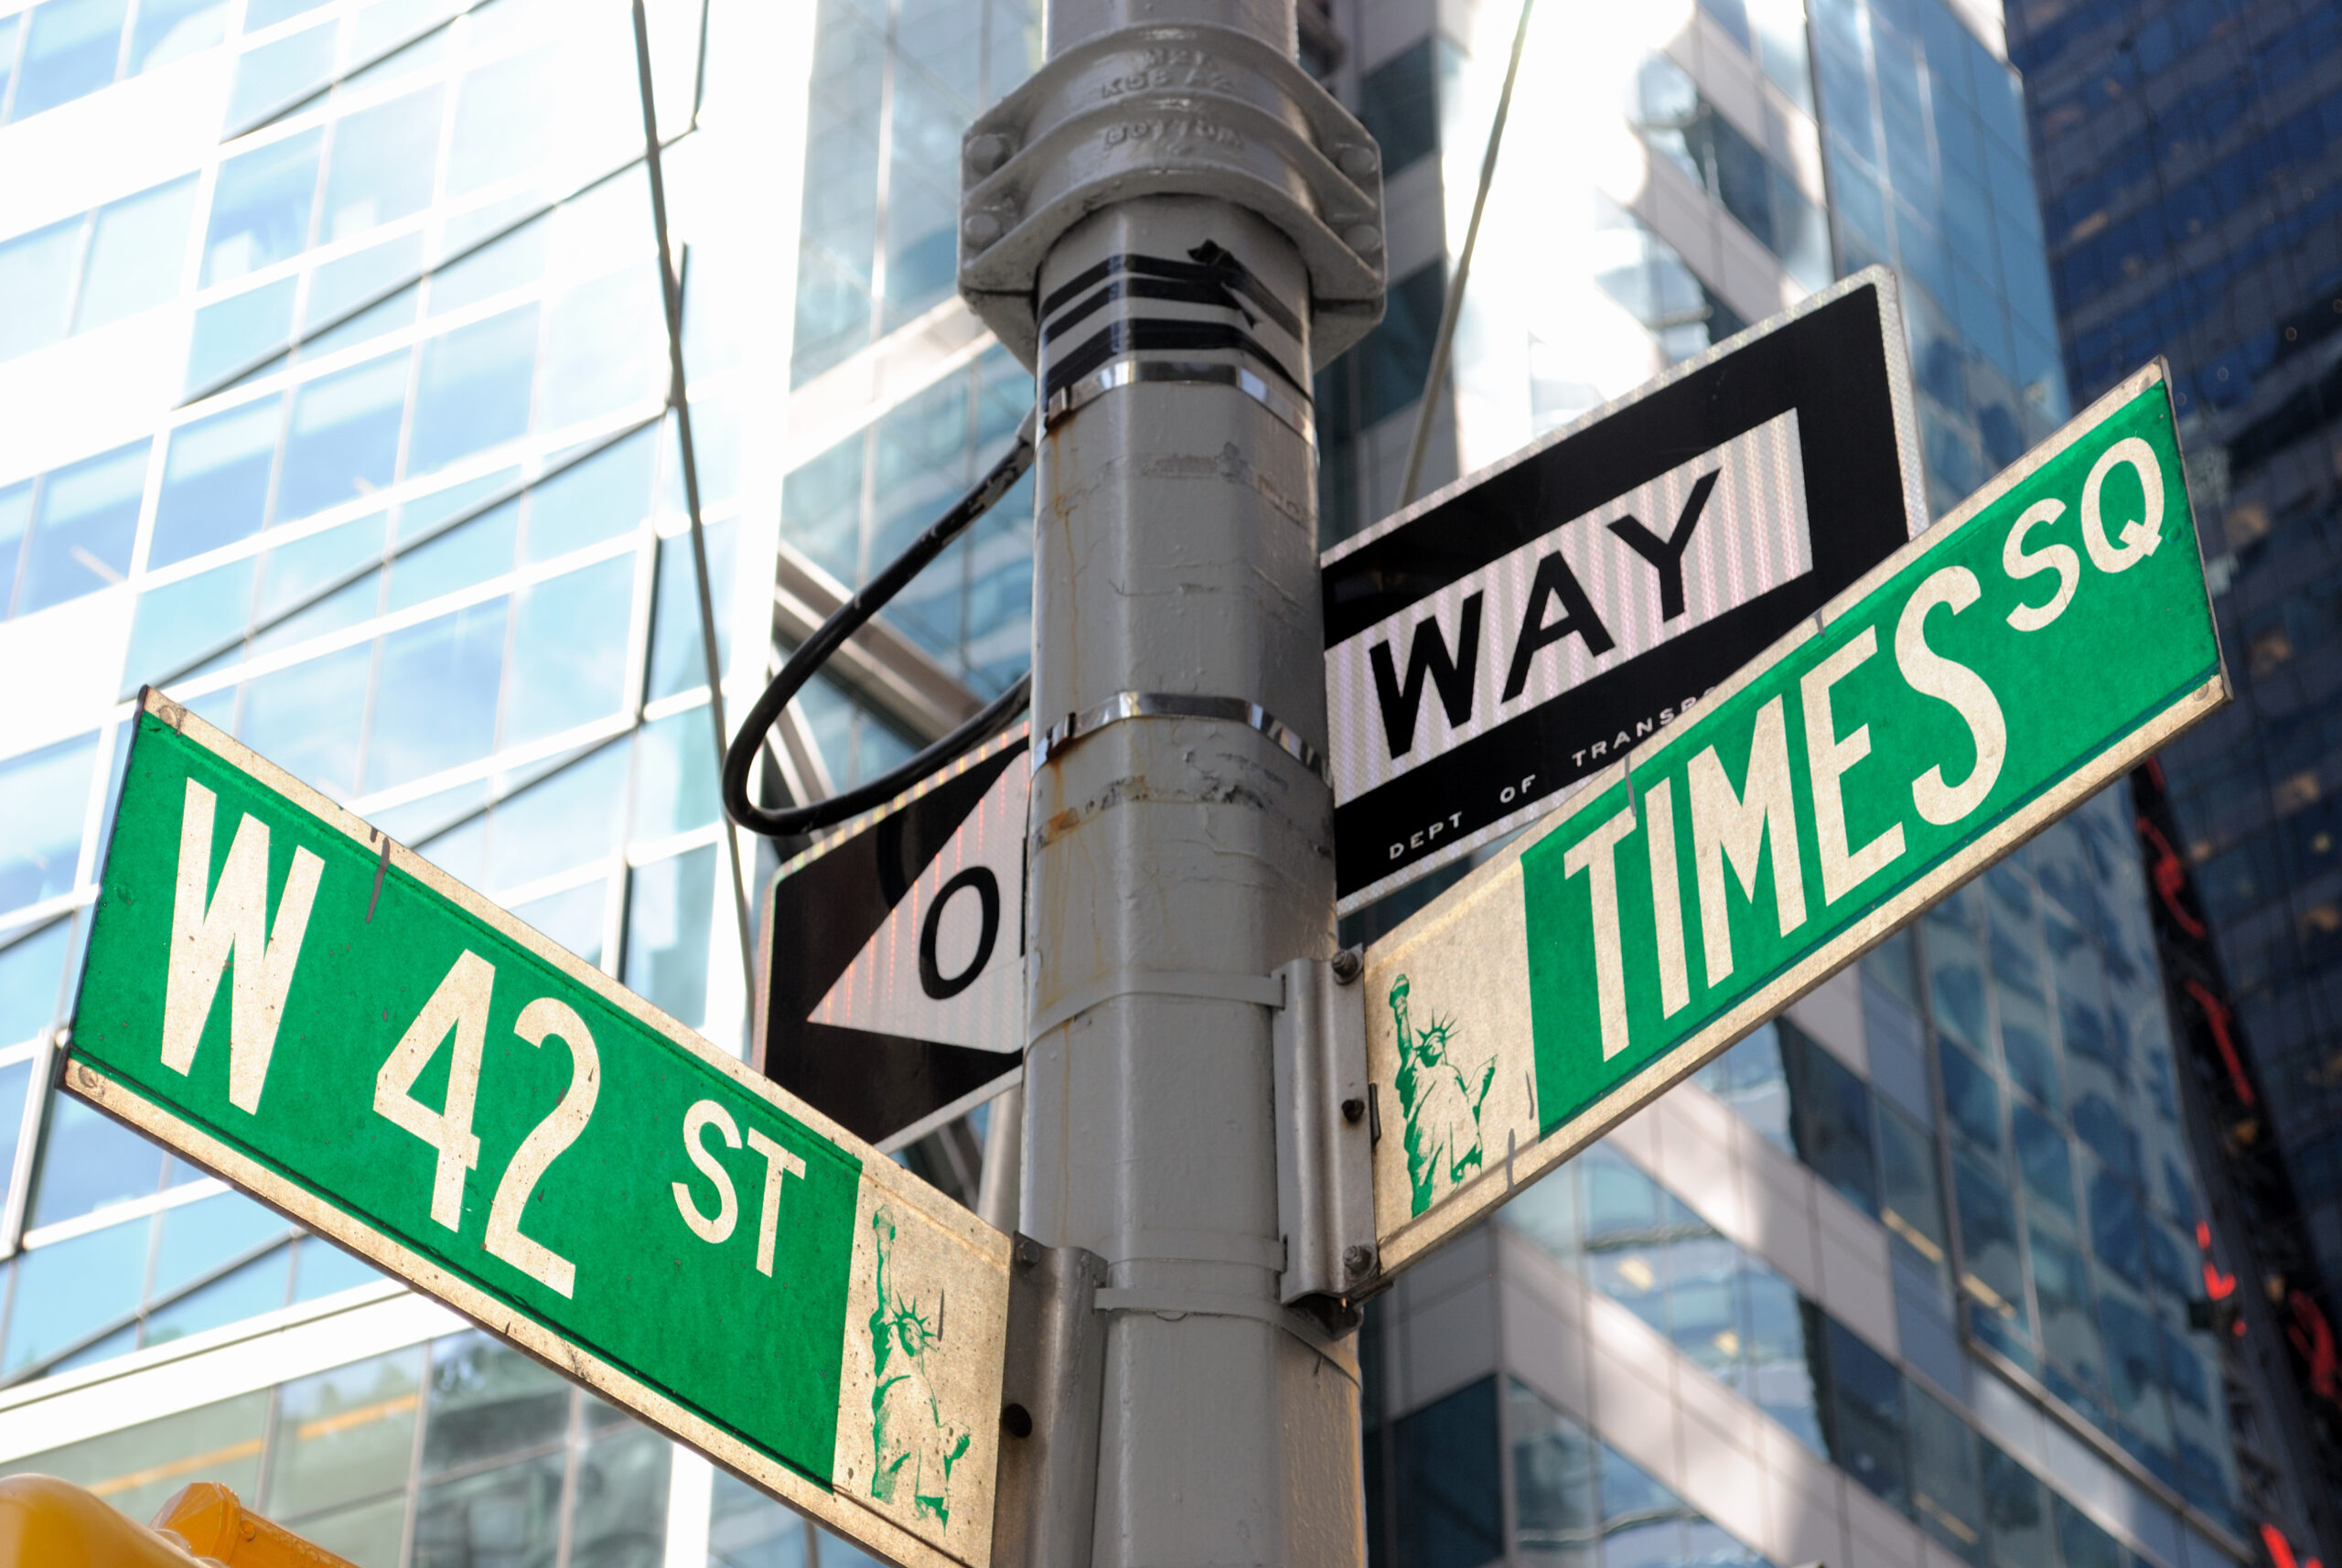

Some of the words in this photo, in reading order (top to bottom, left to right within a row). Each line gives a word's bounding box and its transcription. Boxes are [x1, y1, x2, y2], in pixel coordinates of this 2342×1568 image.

[1368, 468, 1721, 760] WAY
[1389, 811, 1463, 860] DEPT
[1499, 774, 1537, 803] OF
[1571, 686, 1716, 768] TRANSP
[1564, 565, 2007, 1062] TIMES
[2002, 436, 2165, 632] SQ
[160, 777, 326, 1116] W
[372, 948, 601, 1300] 42
[671, 1099, 807, 1278] ST
